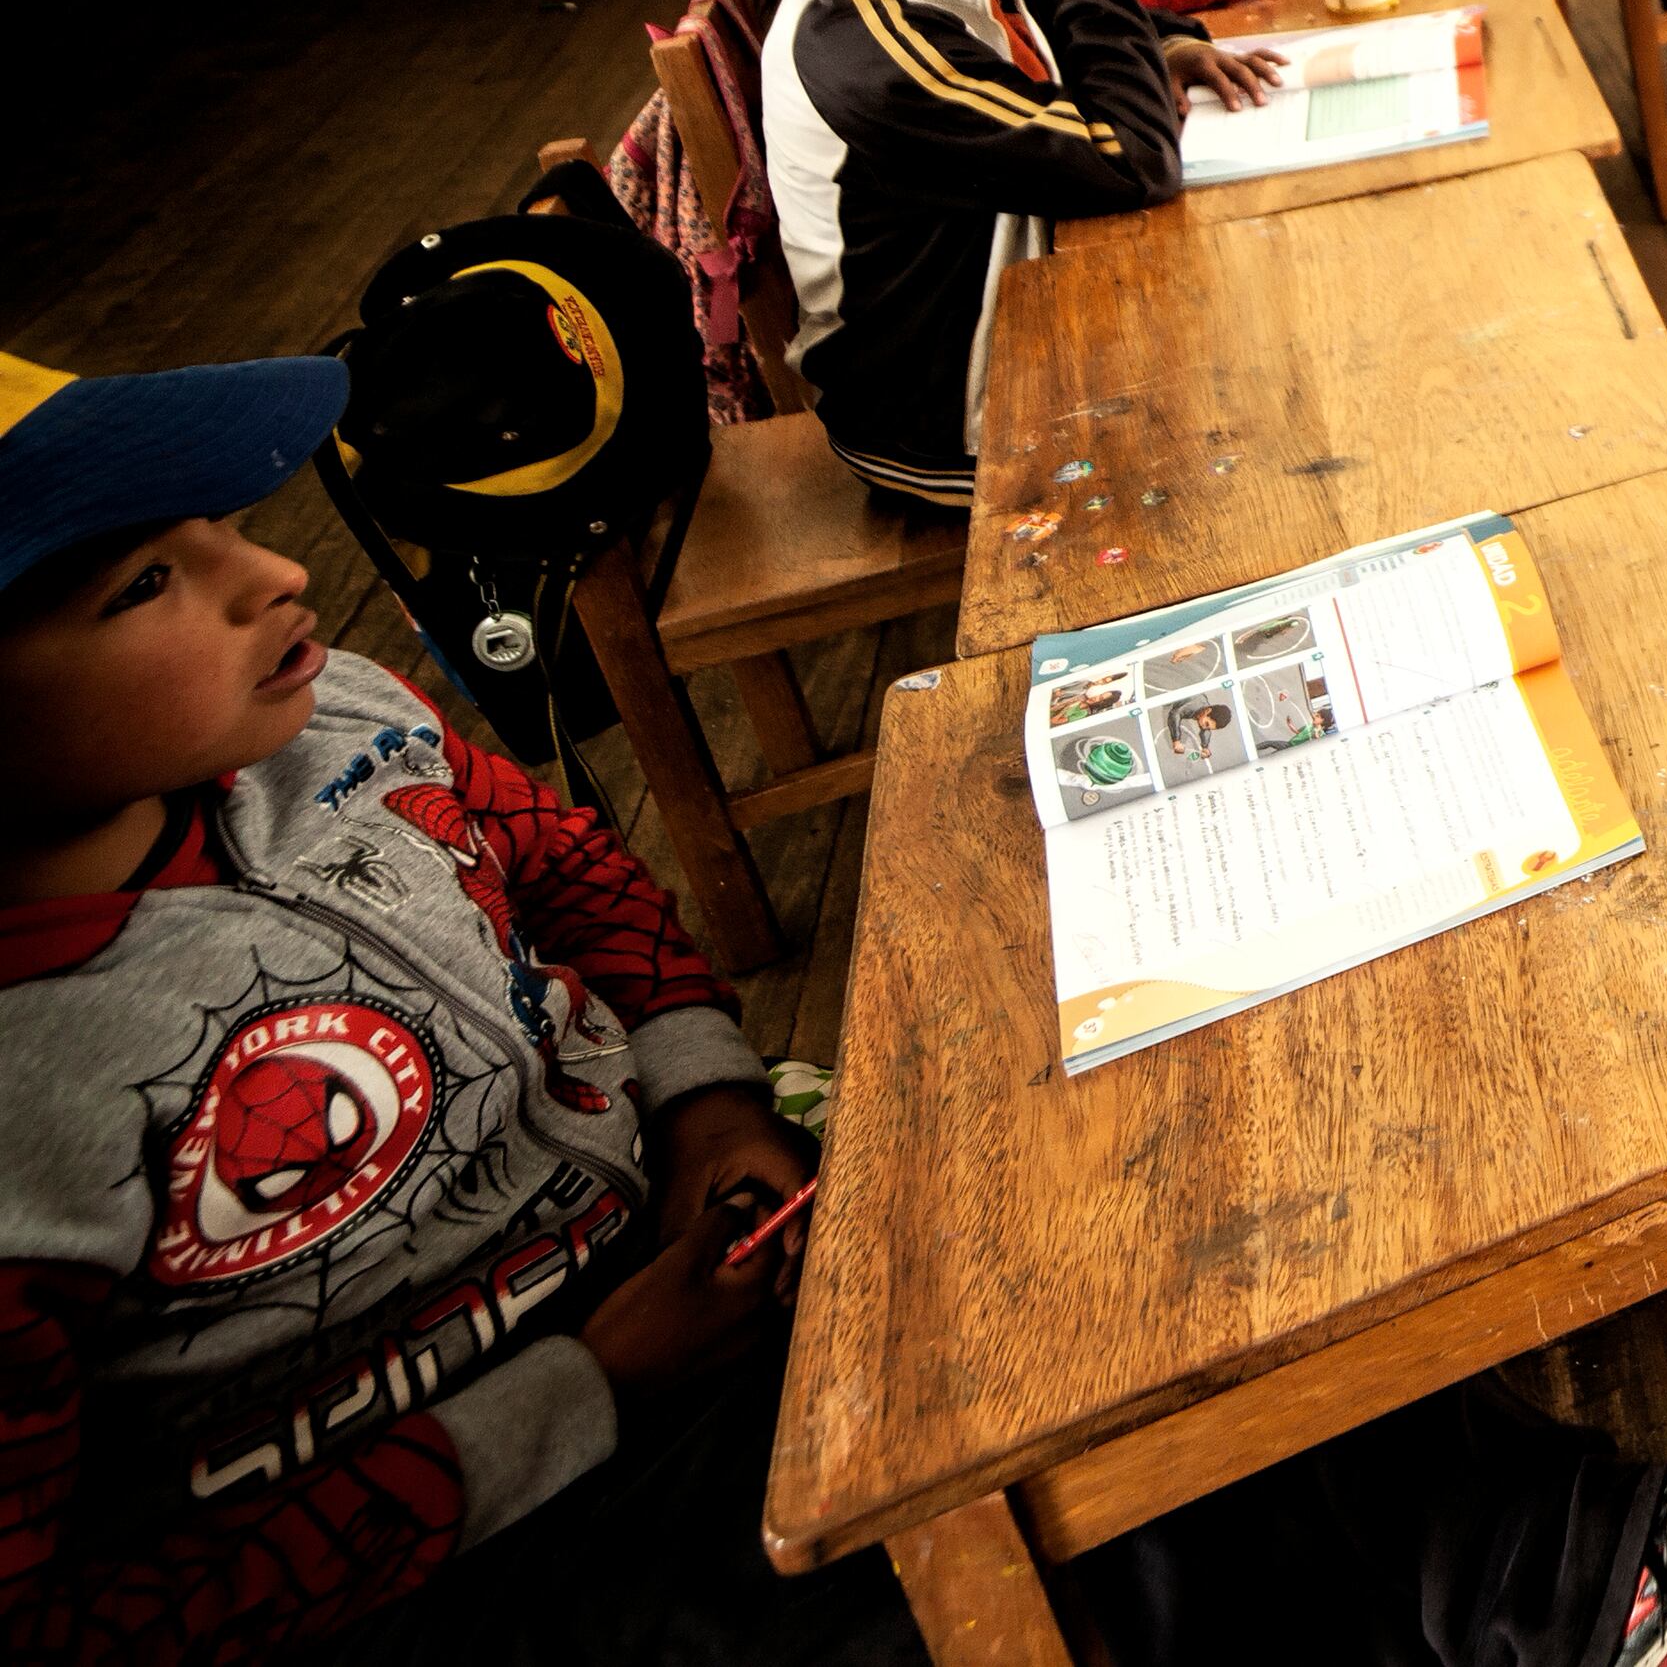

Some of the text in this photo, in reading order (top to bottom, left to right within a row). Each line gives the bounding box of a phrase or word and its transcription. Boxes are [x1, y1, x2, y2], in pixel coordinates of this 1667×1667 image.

[1480, 539, 1543, 622] UNIDAD 2
[1550, 741, 1601, 828] adelante
[225, 1012, 350, 1071] YORK
[368, 1027, 424, 1114] CITY
